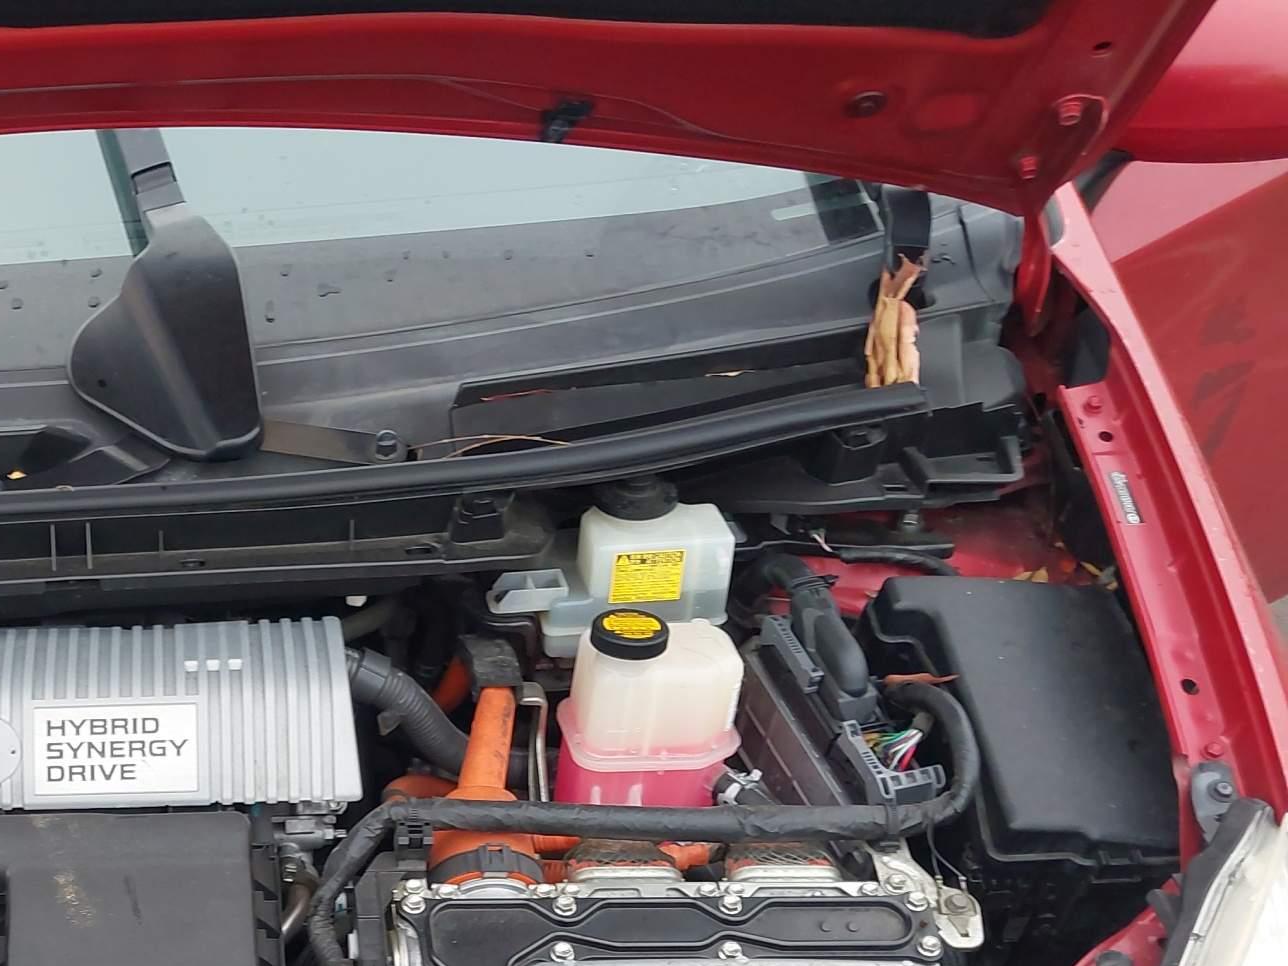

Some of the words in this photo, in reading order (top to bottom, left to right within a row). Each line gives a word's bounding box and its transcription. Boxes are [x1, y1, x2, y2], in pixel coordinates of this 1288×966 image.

[46, 717, 160, 737] HYBRID
[46, 739, 189, 760] SYNERGY
[46, 763, 137, 782] DRIVE
